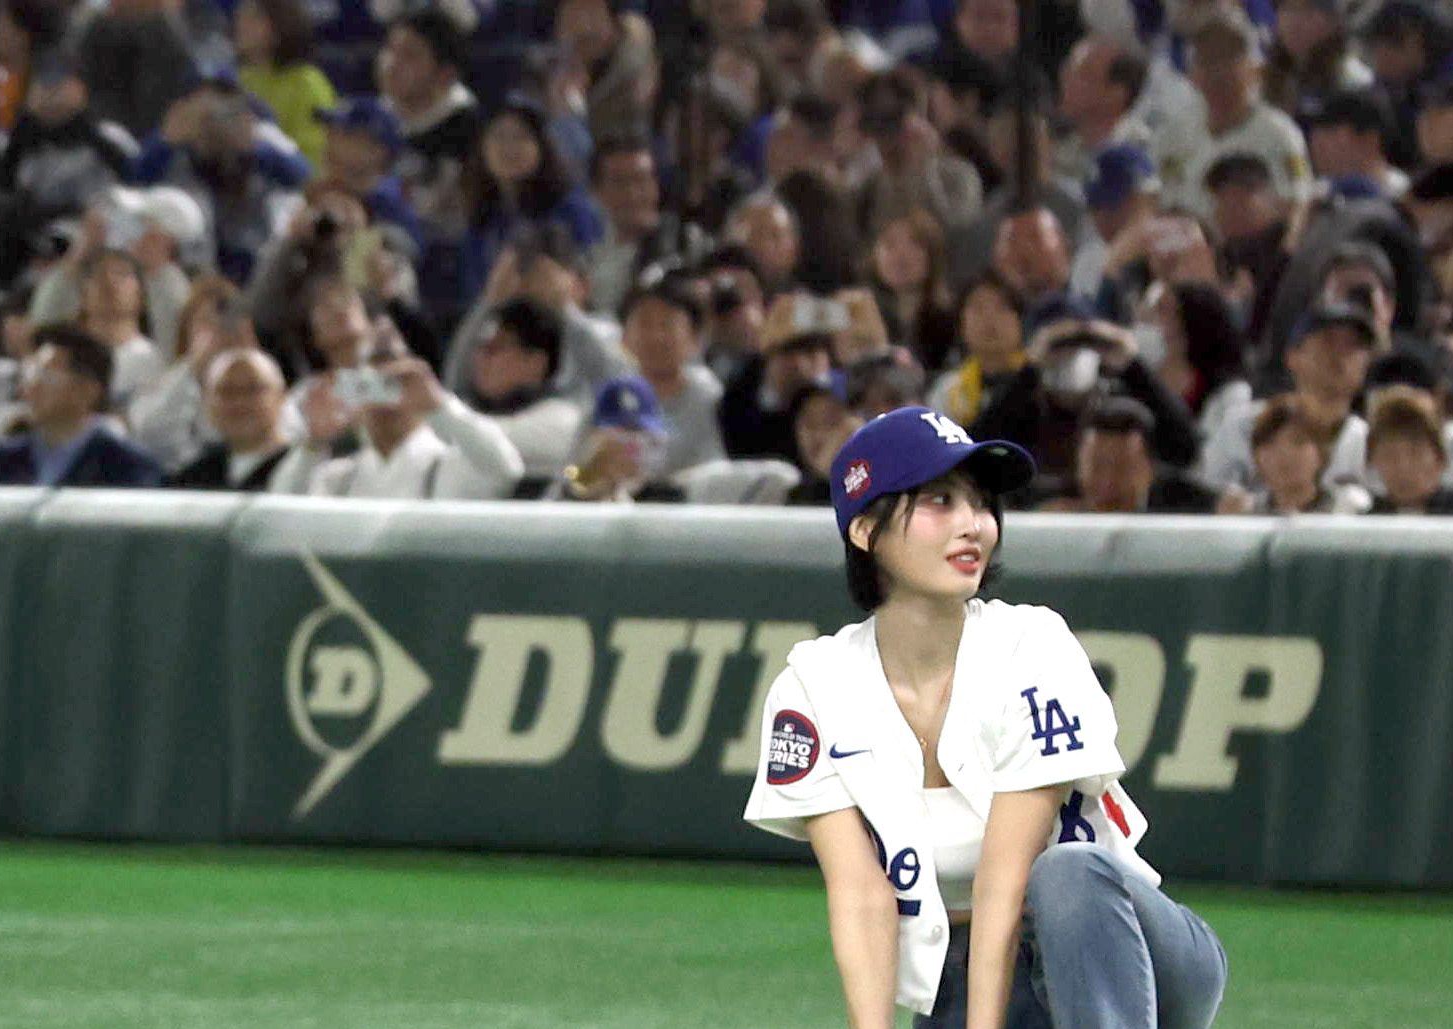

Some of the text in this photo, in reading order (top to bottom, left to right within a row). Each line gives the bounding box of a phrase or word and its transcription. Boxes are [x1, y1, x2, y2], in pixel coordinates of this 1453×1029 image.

[920, 412, 974, 444] LA
[1020, 686, 1085, 757] LA
[769, 750, 810, 769] ERIES
[770, 738, 811, 757] OKYO
